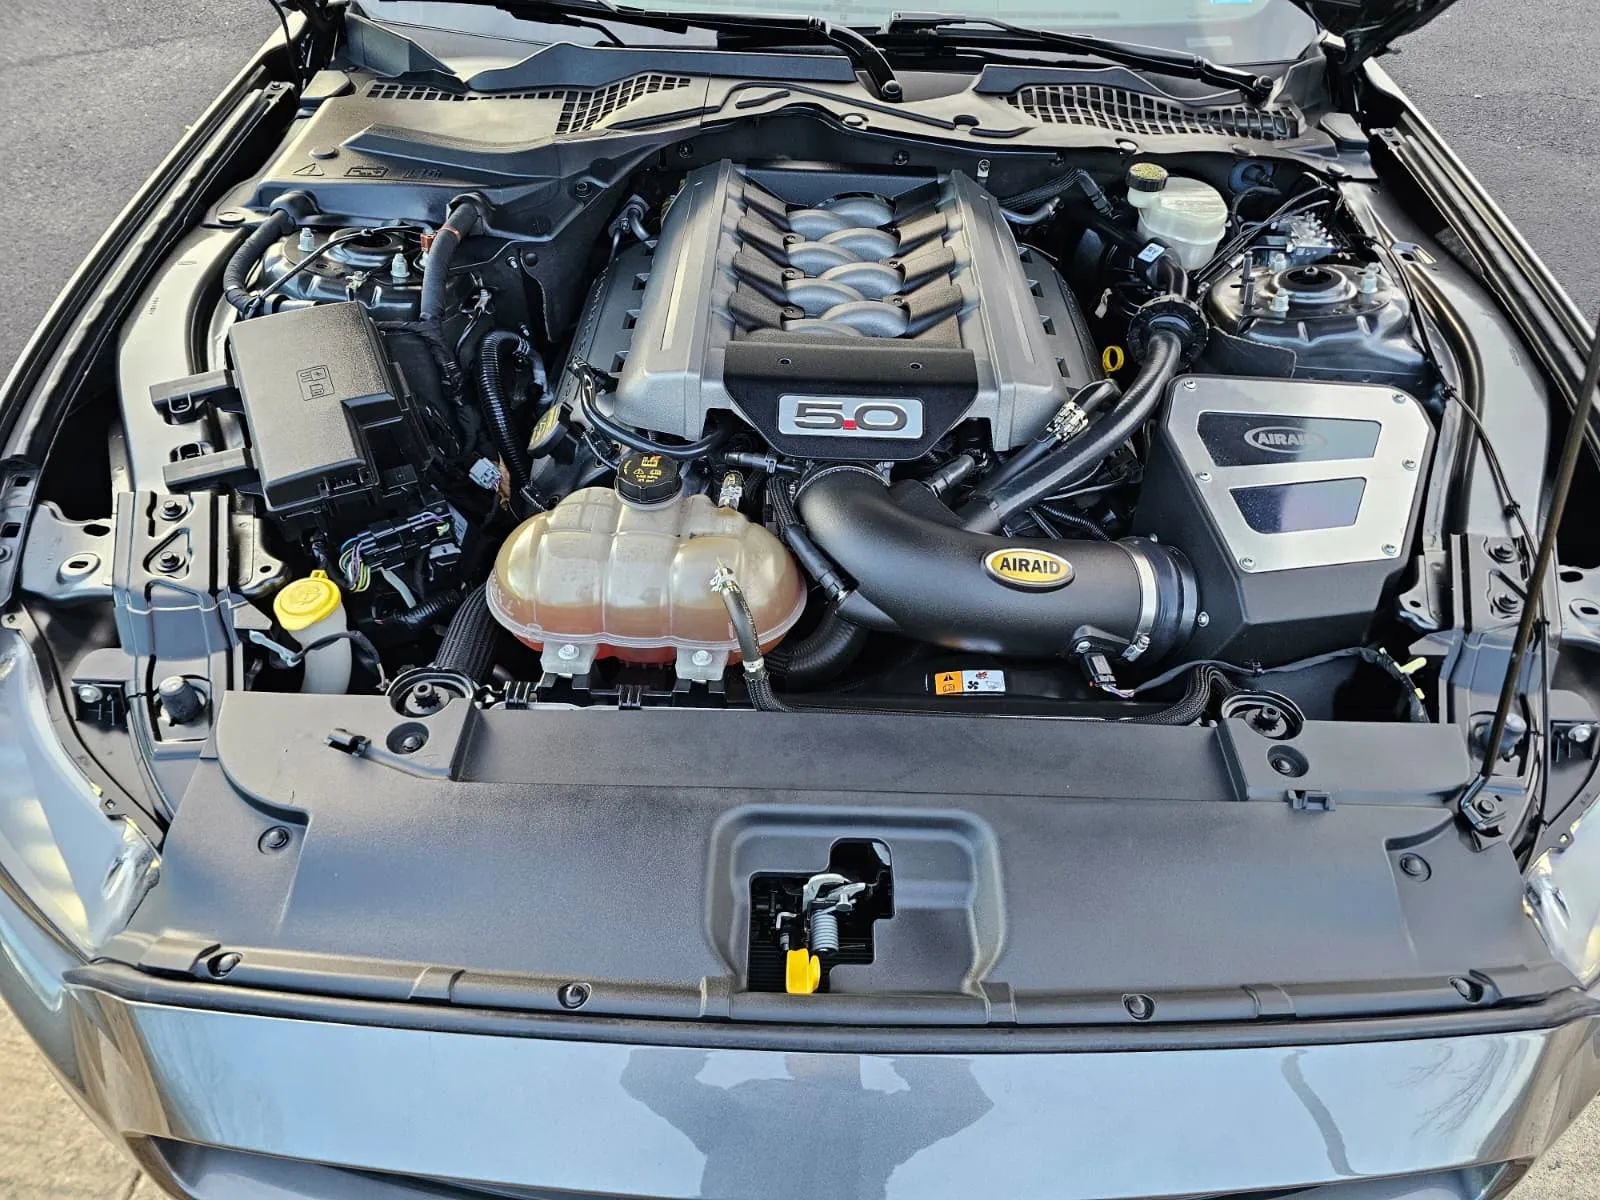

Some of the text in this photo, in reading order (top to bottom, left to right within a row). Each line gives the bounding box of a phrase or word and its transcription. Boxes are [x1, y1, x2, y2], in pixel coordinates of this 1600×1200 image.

[794, 402, 908, 431] 5.0
[1258, 432, 1317, 446] AIRAI
[1000, 557, 1061, 574] AIRAID
